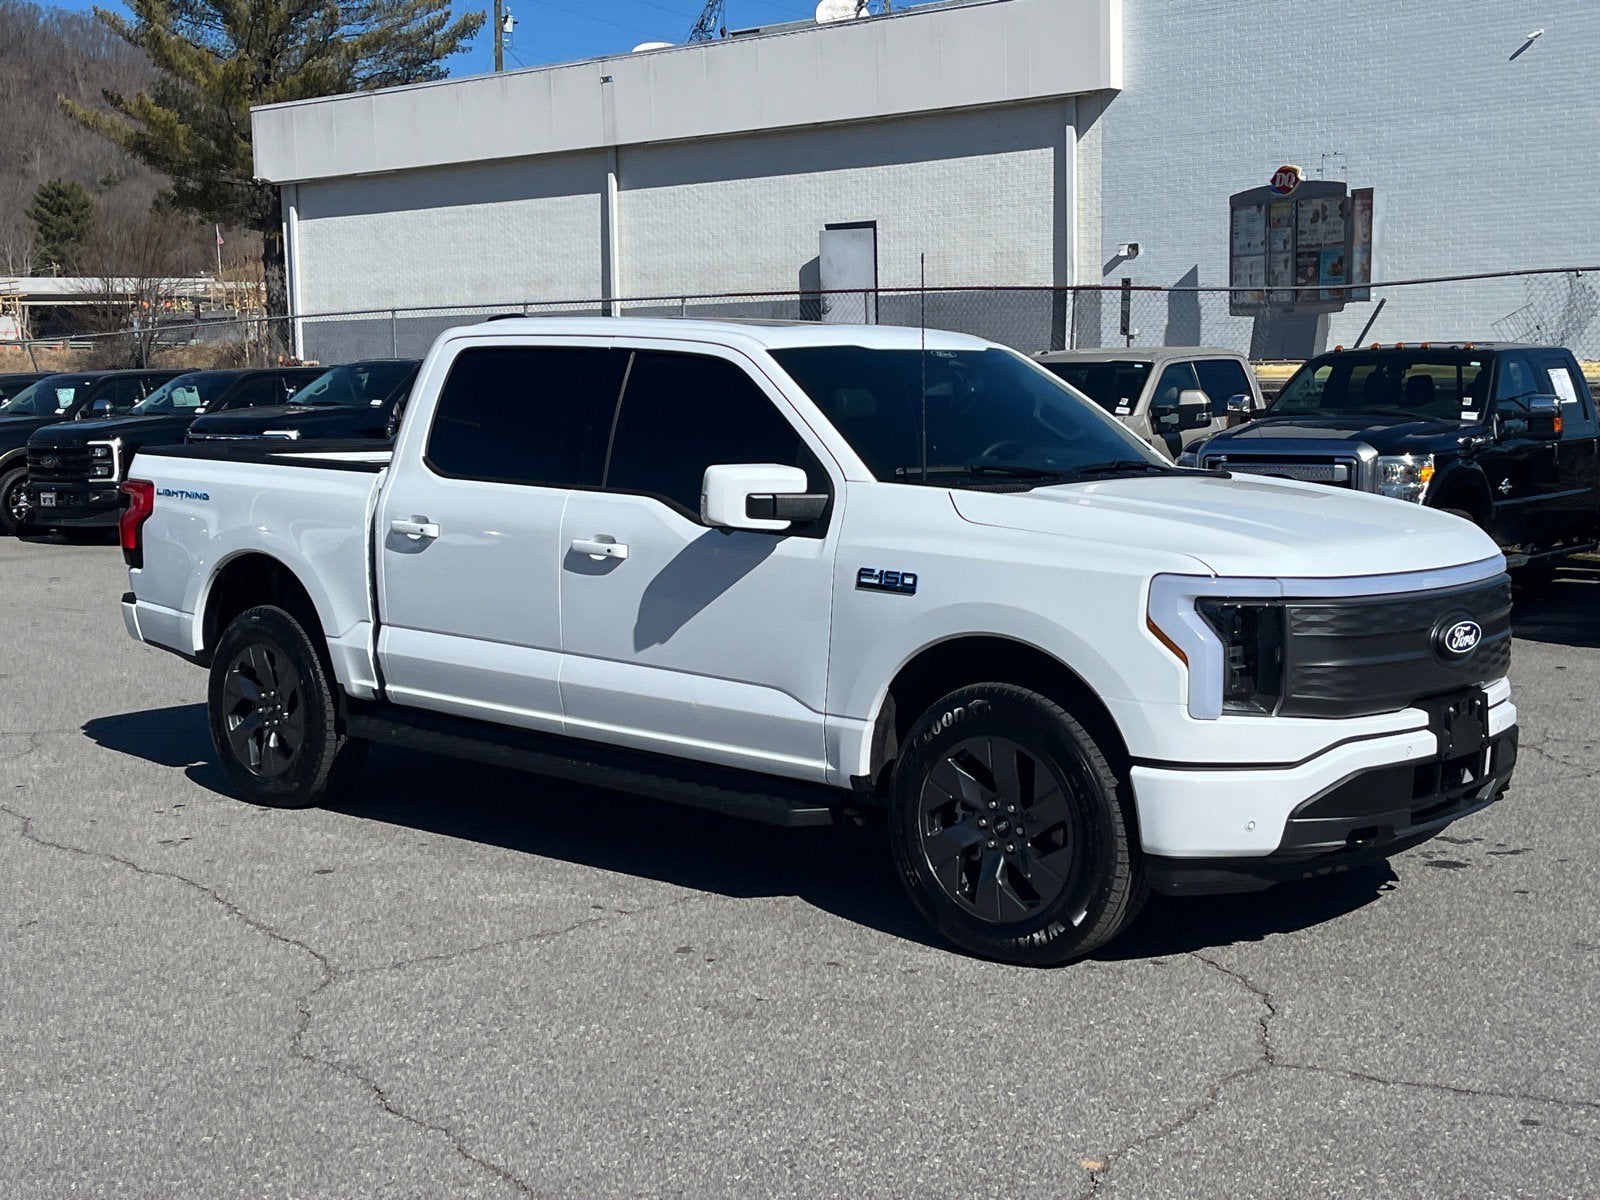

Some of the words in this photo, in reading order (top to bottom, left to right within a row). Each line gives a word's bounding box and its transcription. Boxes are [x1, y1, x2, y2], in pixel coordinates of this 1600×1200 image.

[1275, 172, 1296, 189] DQ
[156, 488, 210, 501] LIGHTNING
[856, 567, 918, 595] F-150
[1452, 625, 1477, 649] Ford
